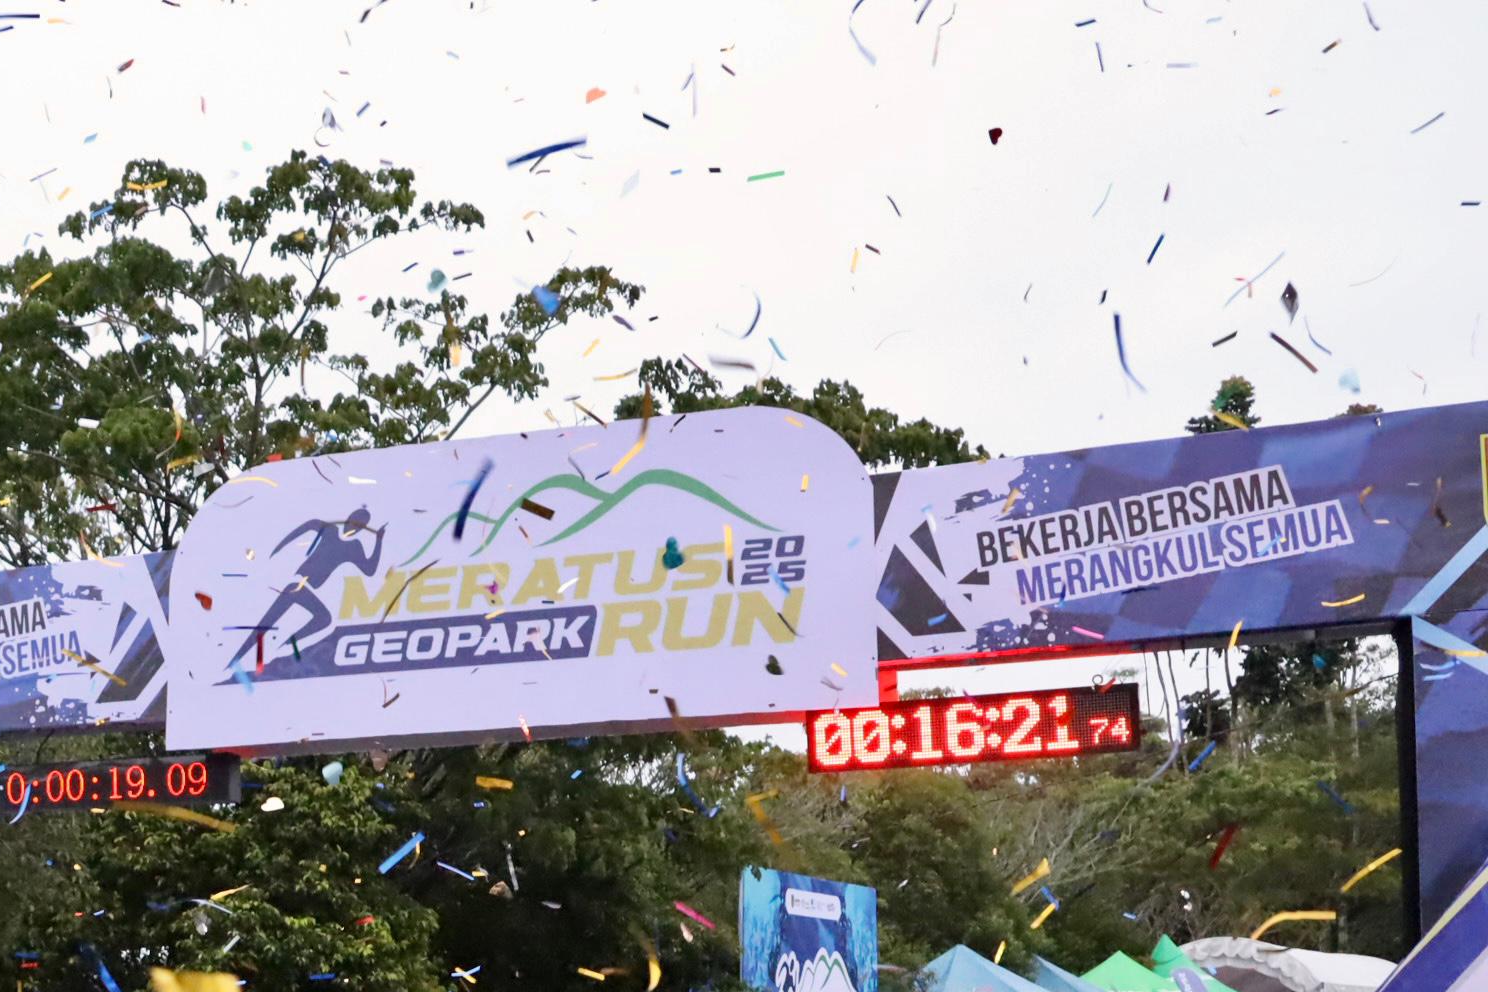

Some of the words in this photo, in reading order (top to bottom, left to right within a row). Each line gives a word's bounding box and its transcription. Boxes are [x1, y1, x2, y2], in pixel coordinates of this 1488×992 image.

[741, 536, 804, 560] 20
[979, 506, 1114, 566] BEKERJA
[1129, 471, 1289, 537] BERSAMA
[1017, 534, 1221, 605] MERANGKUL
[1224, 504, 1348, 563] SEMUA
[339, 542, 725, 620] MERATUS
[741, 560, 805, 585] 25
[3, 631, 79, 676] SEMUA
[334, 605, 588, 666] GEOPARK
[596, 587, 804, 656] RUN
[814, 695, 1080, 767] 00:16:21
[1091, 717, 1130, 744] 74
